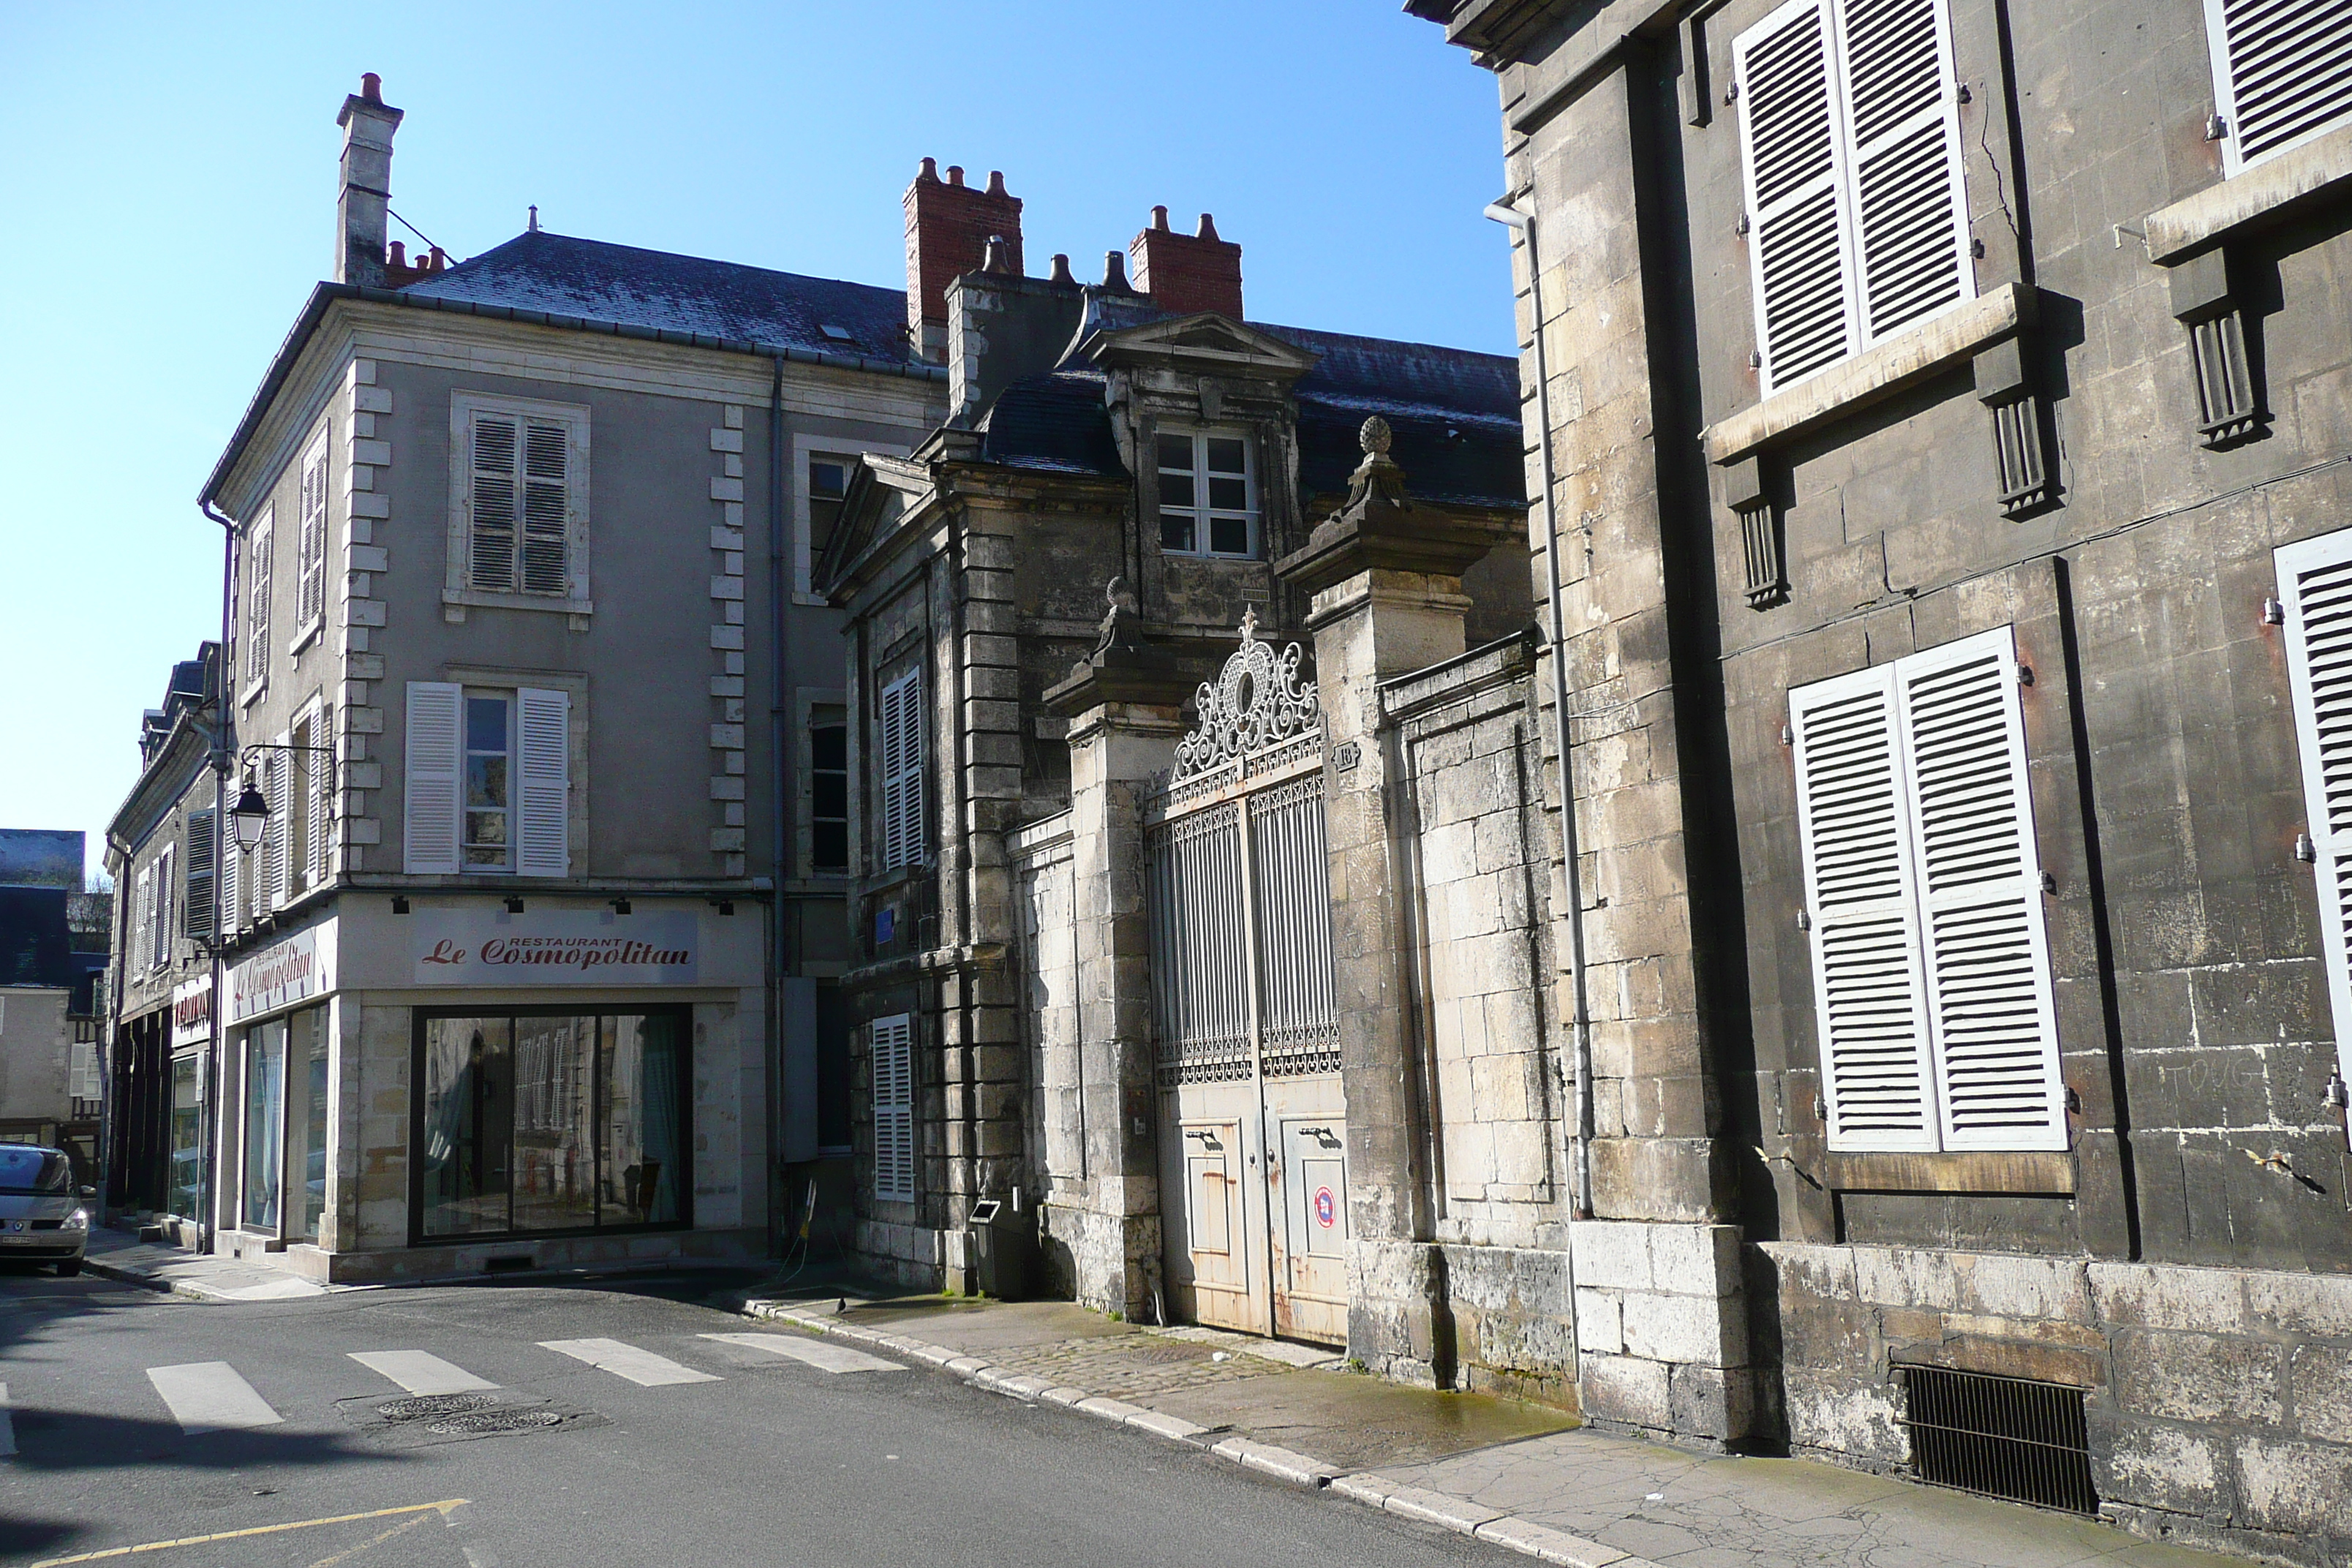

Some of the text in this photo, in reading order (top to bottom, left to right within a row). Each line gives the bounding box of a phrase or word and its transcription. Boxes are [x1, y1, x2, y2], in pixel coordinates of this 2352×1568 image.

[421, 938, 690, 970] Le Cosmopolitan
[510, 938, 622, 947] RESTAURANT
[248, 943, 310, 999] Cosmopolitan
